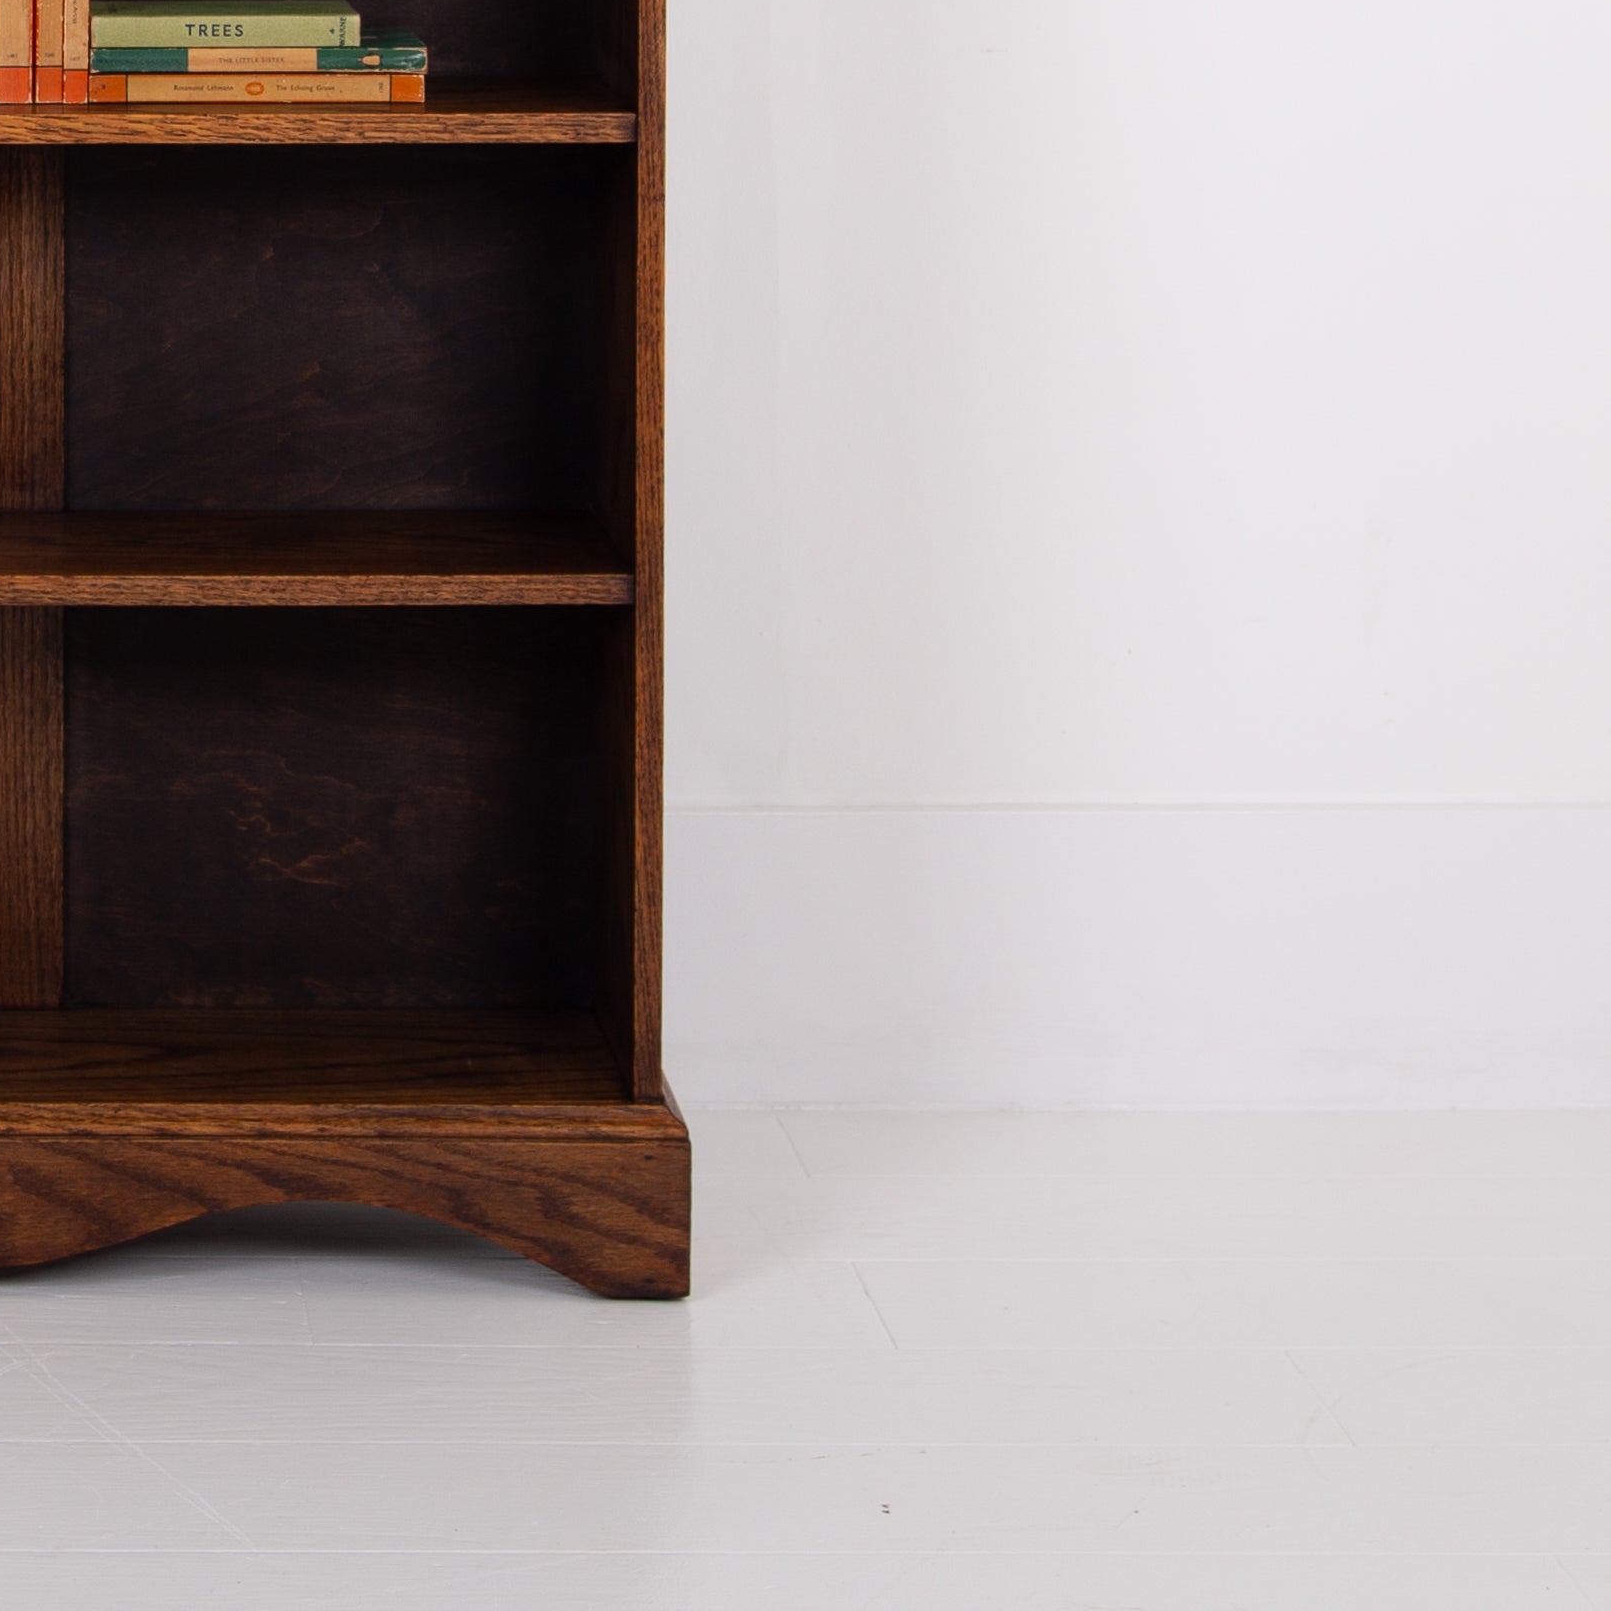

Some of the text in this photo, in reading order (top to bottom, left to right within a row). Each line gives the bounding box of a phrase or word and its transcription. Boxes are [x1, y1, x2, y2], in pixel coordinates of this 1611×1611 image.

[185, 24, 244, 37] TREES
[339, 17, 347, 47] WARNE
[290, 84, 313, 92] Echoing
